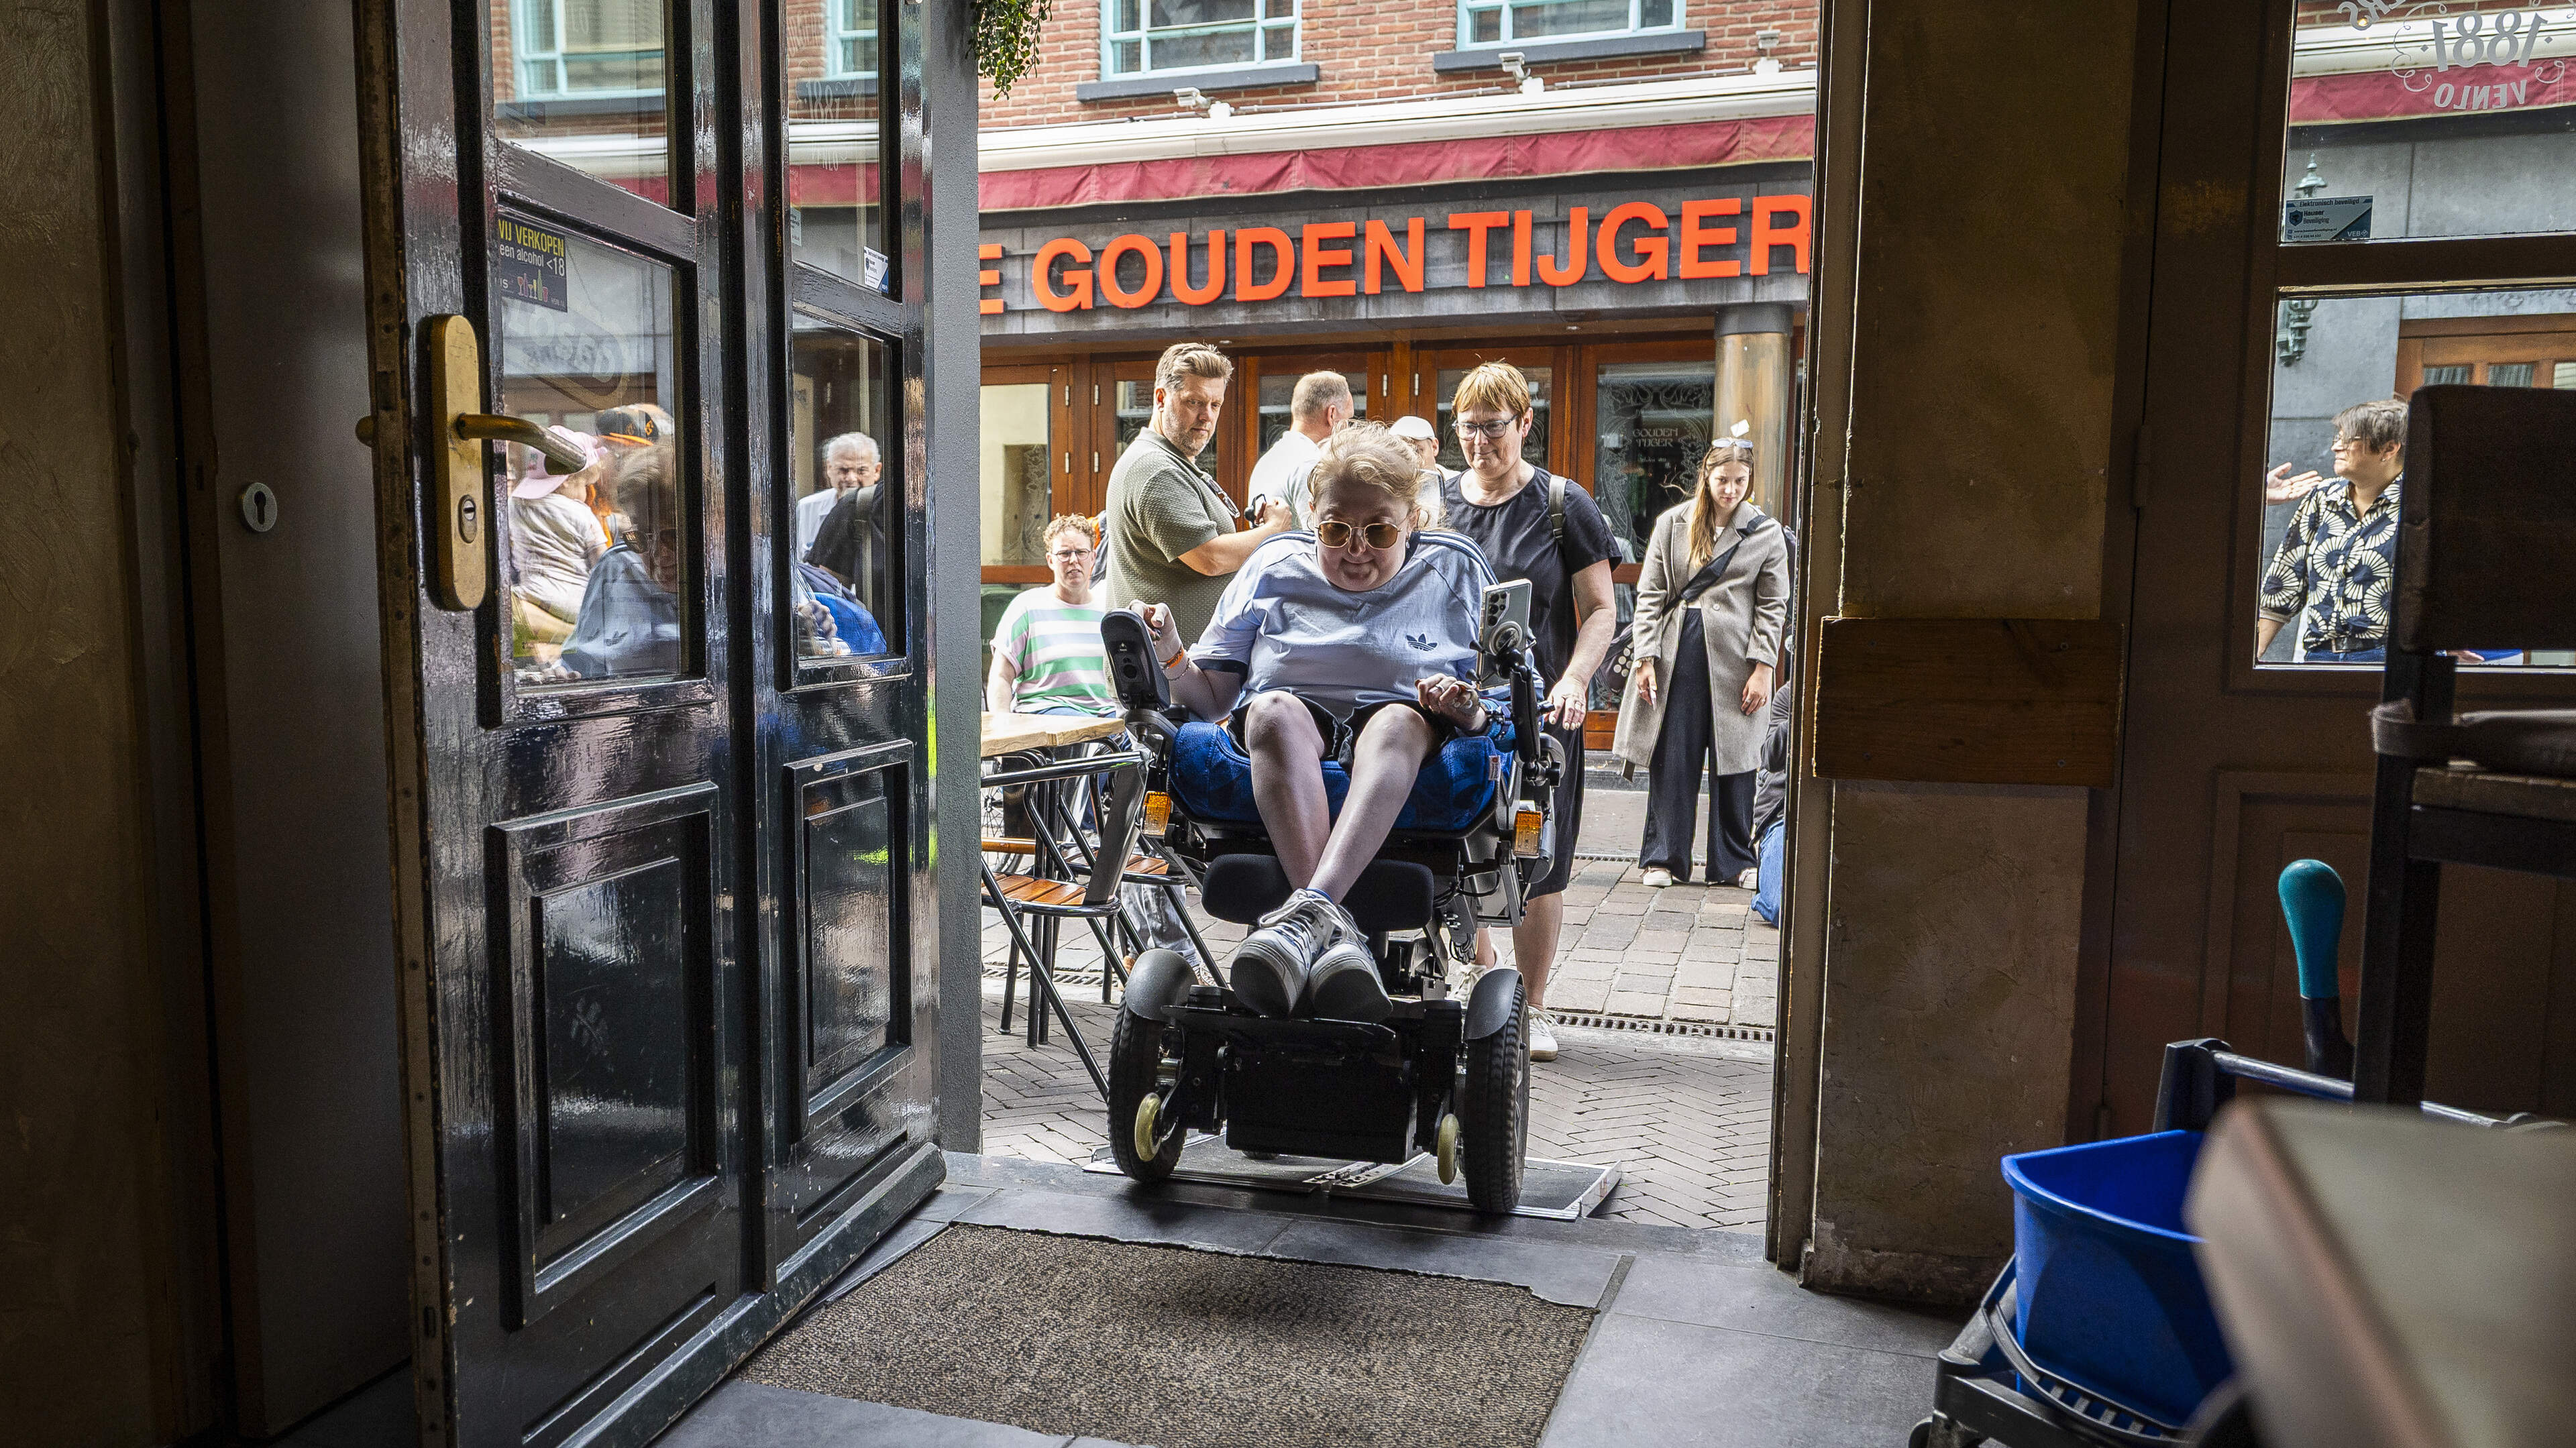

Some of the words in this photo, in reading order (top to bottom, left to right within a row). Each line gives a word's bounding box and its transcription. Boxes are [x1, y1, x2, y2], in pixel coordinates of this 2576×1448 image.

[515, 224, 564, 257] VERKOPEN
[1031, 217, 1426, 313] GOUDEN
[1448, 194, 1813, 288] TIJGER
[517, 248, 544, 267] alcohol
[546, 257, 565, 276] <18
[1632, 428, 1678, 437] GOUDEN
